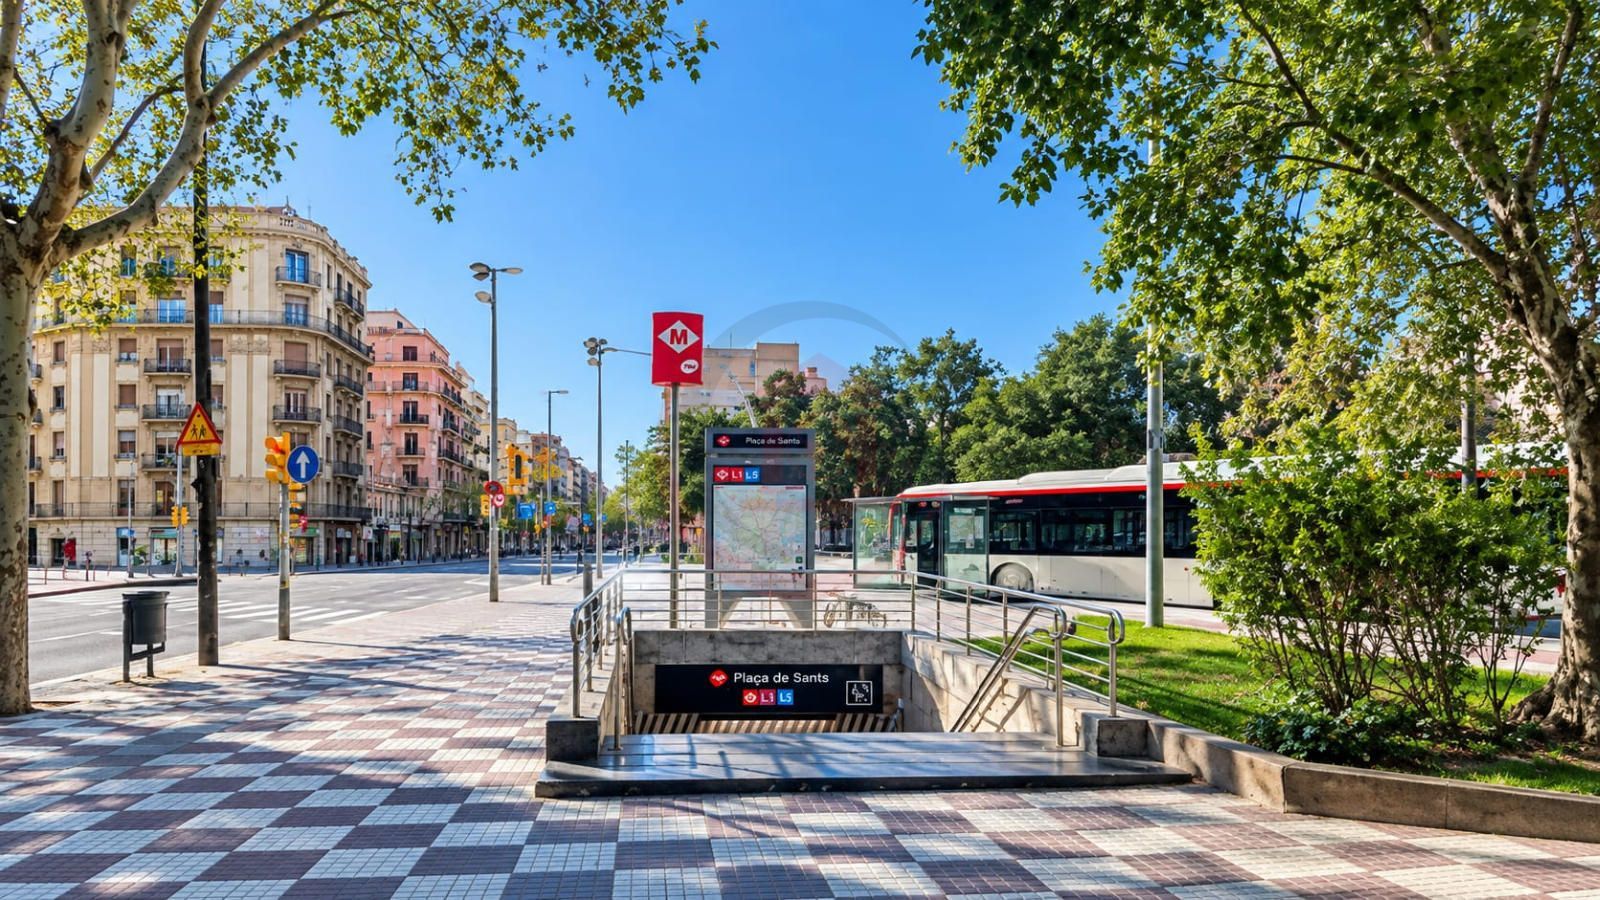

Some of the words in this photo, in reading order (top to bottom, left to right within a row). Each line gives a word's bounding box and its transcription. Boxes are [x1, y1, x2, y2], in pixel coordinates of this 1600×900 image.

[670, 329, 688, 344] M
[732, 470, 743, 479] L1
[745, 470, 758, 479] L5
[733, 672, 769, 686] Plaça
[772, 672, 790, 683] de
[793, 672, 830, 683] Sants
[780, 692, 792, 703] L5
